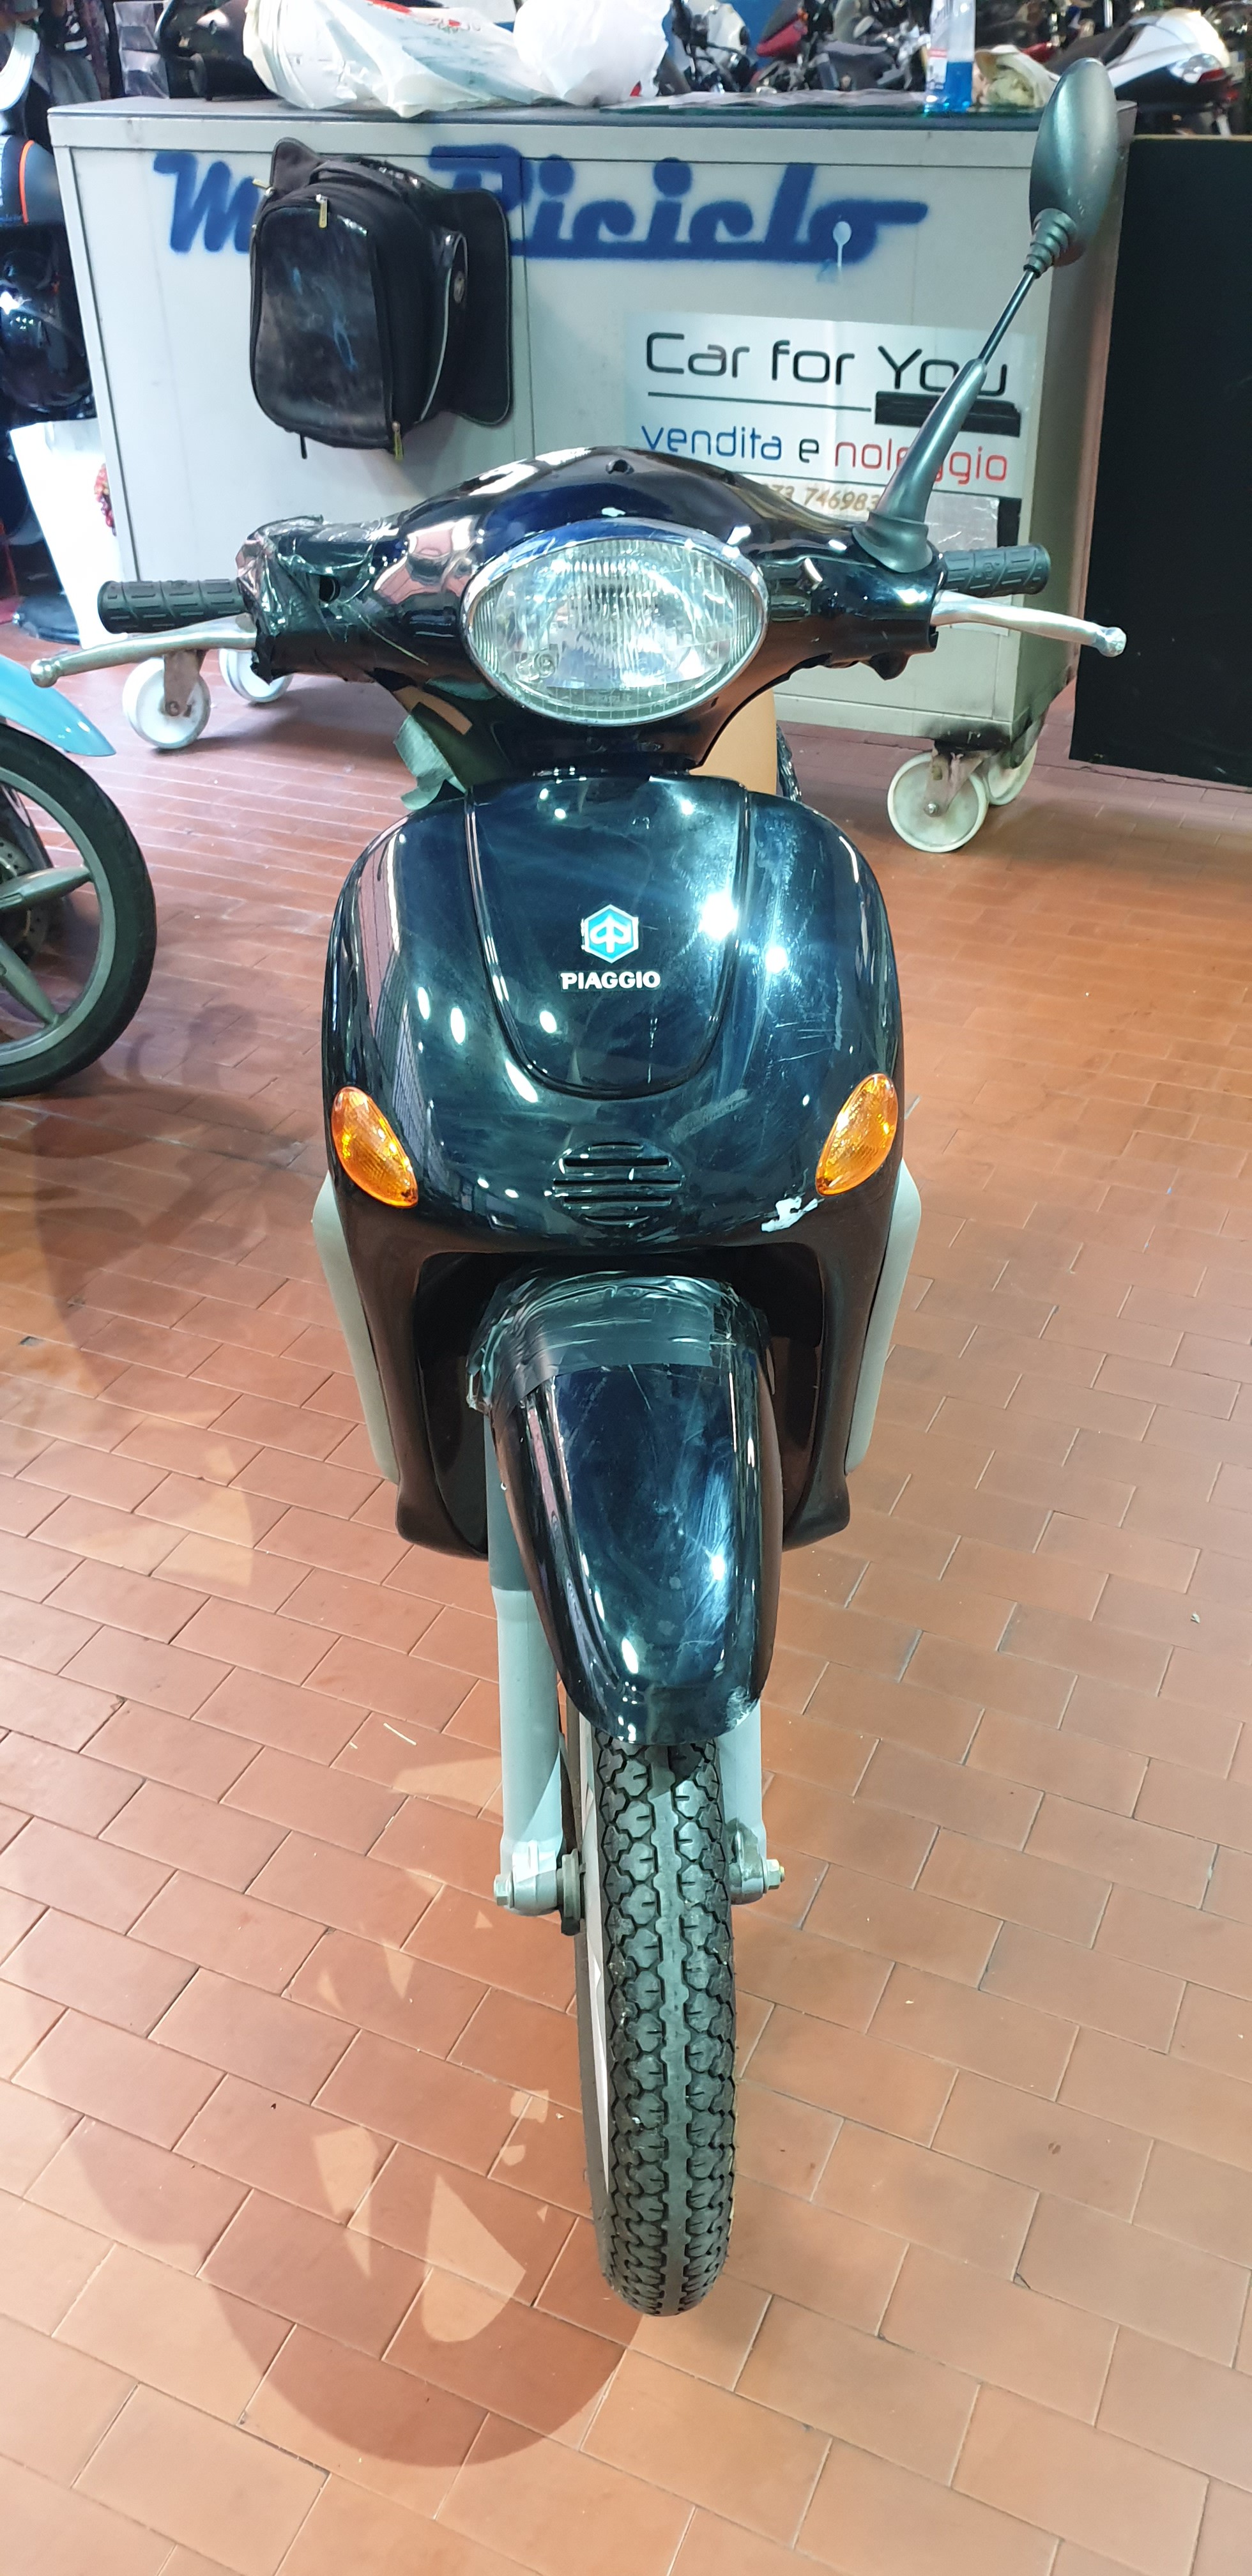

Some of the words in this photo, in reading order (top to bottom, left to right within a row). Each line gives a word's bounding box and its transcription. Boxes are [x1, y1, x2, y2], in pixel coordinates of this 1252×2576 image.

[646, 332, 750, 378] Car
[772, 340, 855, 385] for
[641, 425, 782, 461] vendita
[799, 438, 819, 463] e
[560, 971, 661, 990] PIAGGIO
